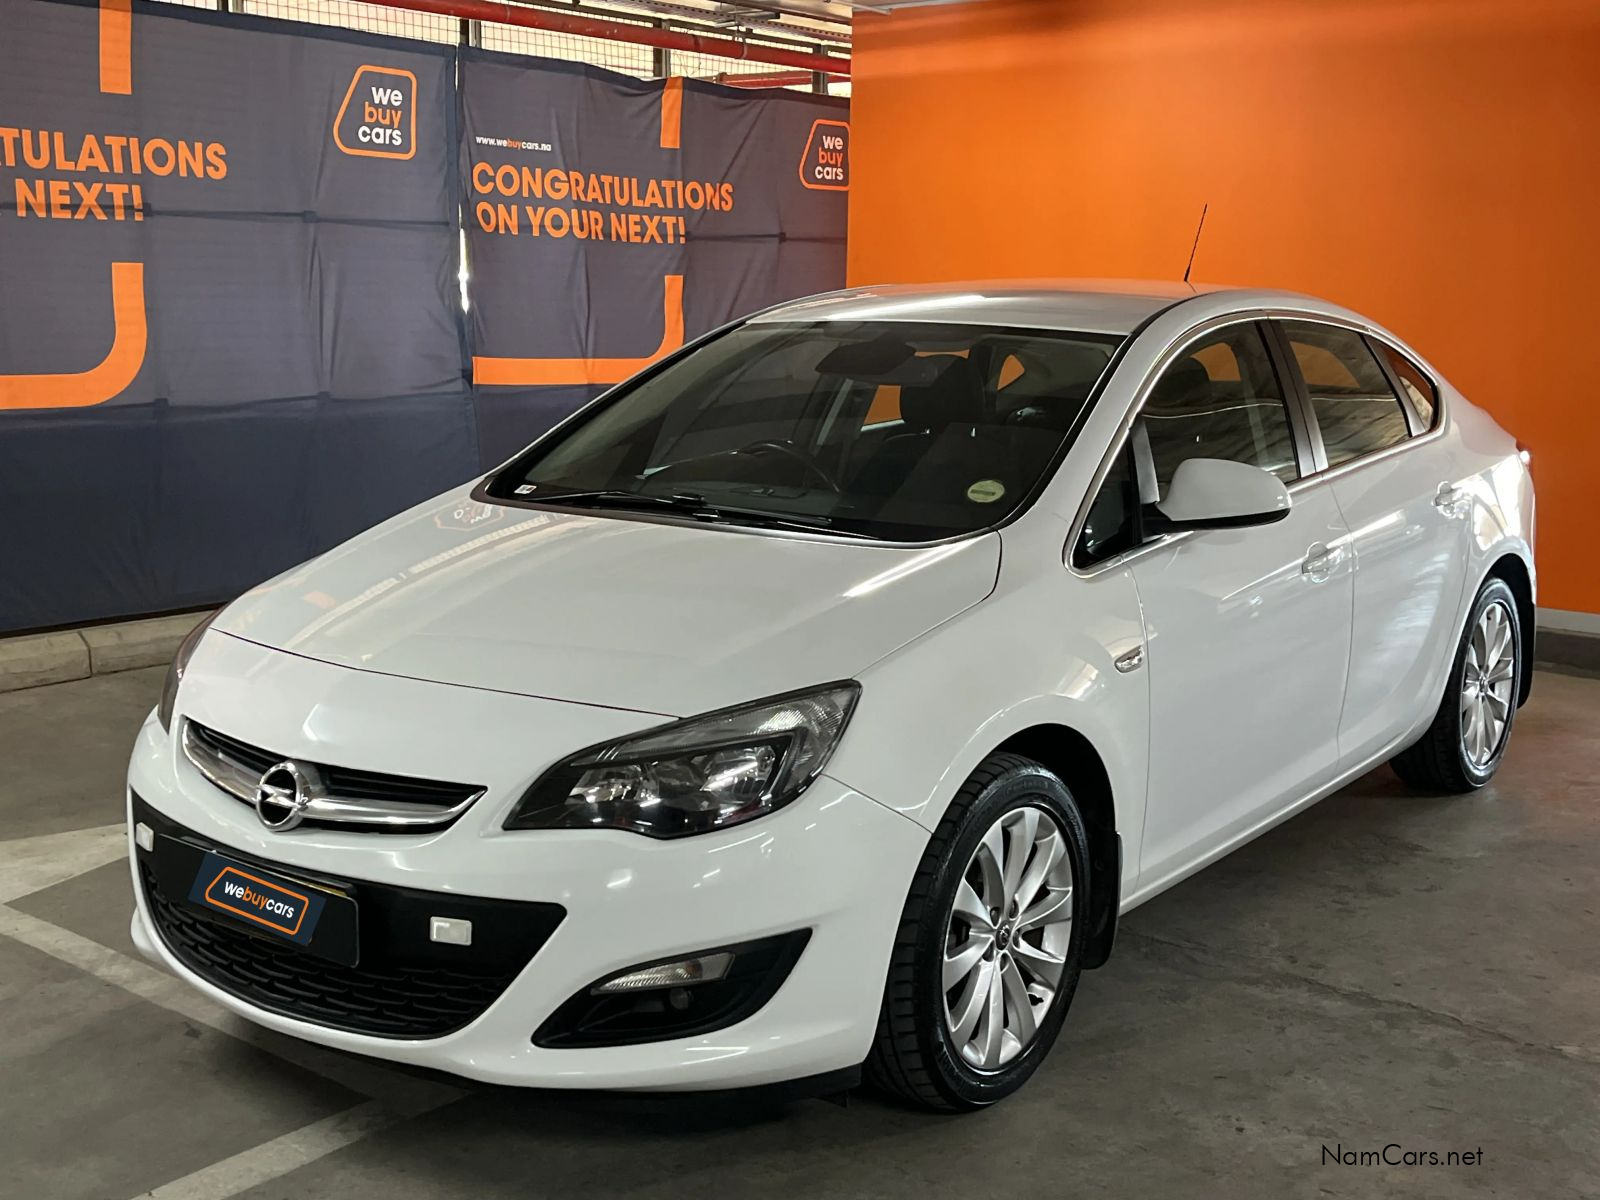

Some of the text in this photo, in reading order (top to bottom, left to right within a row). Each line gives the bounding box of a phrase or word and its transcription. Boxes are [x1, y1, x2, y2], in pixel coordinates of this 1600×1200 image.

[371, 86, 402, 107] we
[364, 102, 402, 129] buy
[358, 125, 402, 146] cars
[822, 135, 844, 151] we
[0, 127, 227, 180] TULATIONS
[818, 149, 843, 167] buy
[815, 164, 844, 181] cars
[472, 161, 734, 211] CONGRATULATIONS
[15, 179, 144, 222] NEXT!
[476, 201, 687, 245] ON YOUR NEXT!
